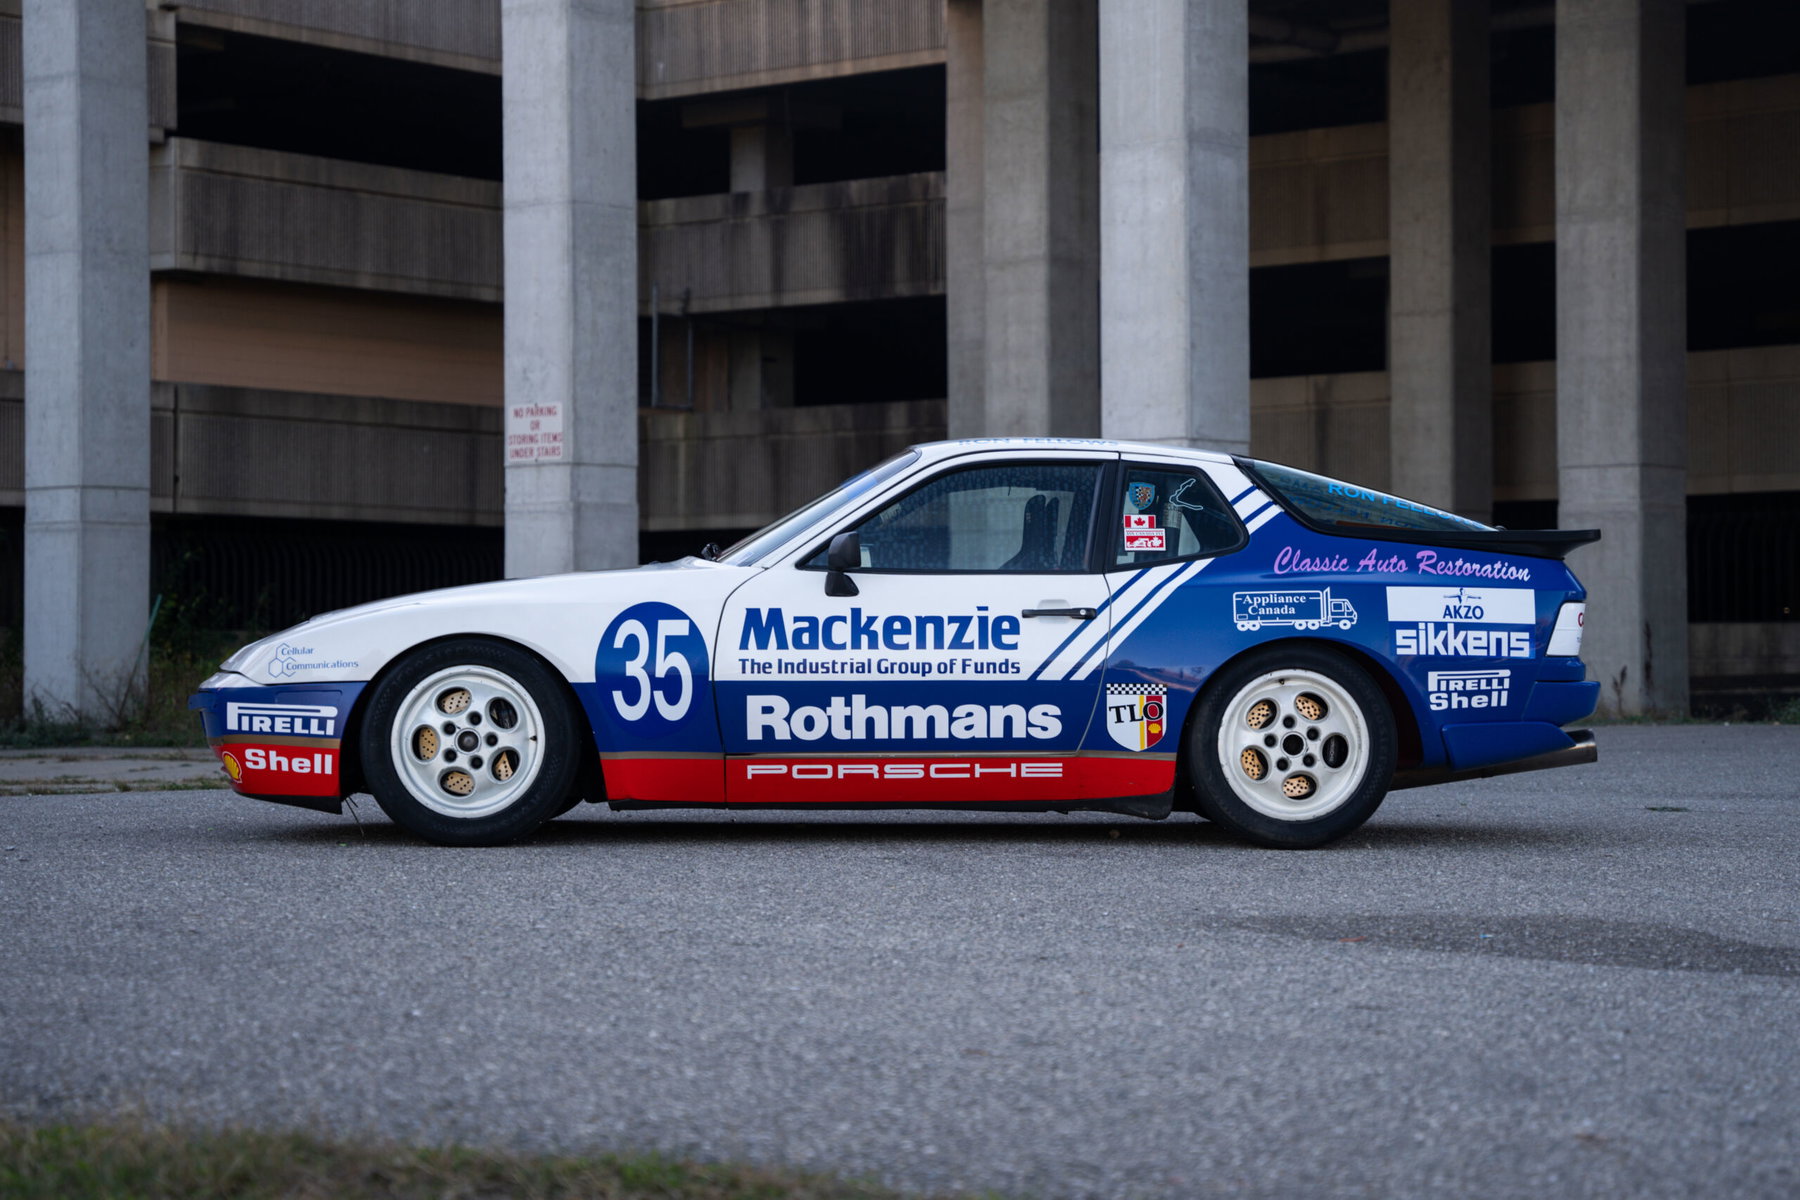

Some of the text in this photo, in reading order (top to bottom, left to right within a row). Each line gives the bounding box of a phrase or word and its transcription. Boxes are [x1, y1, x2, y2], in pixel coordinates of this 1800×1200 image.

[513, 406, 557, 418] NO PARKING
[530, 420, 540, 430] OR
[508, 432, 563, 445] STORING ITEMS
[510, 446, 561, 458] UNDER STAIRS
[1327, 482, 1375, 502] RON
[1273, 546, 1531, 582] Classic Auto Restoration
[1242, 594, 1307, 606] Appliance
[1247, 604, 1296, 615] Canada
[1442, 605, 1484, 620] AKZO
[739, 606, 1021, 651] Mackenzie
[1395, 622, 1531, 658] sikkens
[281, 647, 314, 655] Cellular
[286, 660, 359, 671] Communications
[611, 618, 693, 721] 35
[738, 658, 1021, 677] The Industrial Group of Funds
[1428, 669, 1511, 692] PIRELLI
[1429, 690, 1508, 711] Shell
[226, 701, 339, 736] PIRELLI
[746, 694, 1063, 741] Rothmans
[1108, 701, 1164, 724] TLO
[244, 748, 333, 775] Shell
[746, 763, 1063, 779] PORSCHE
